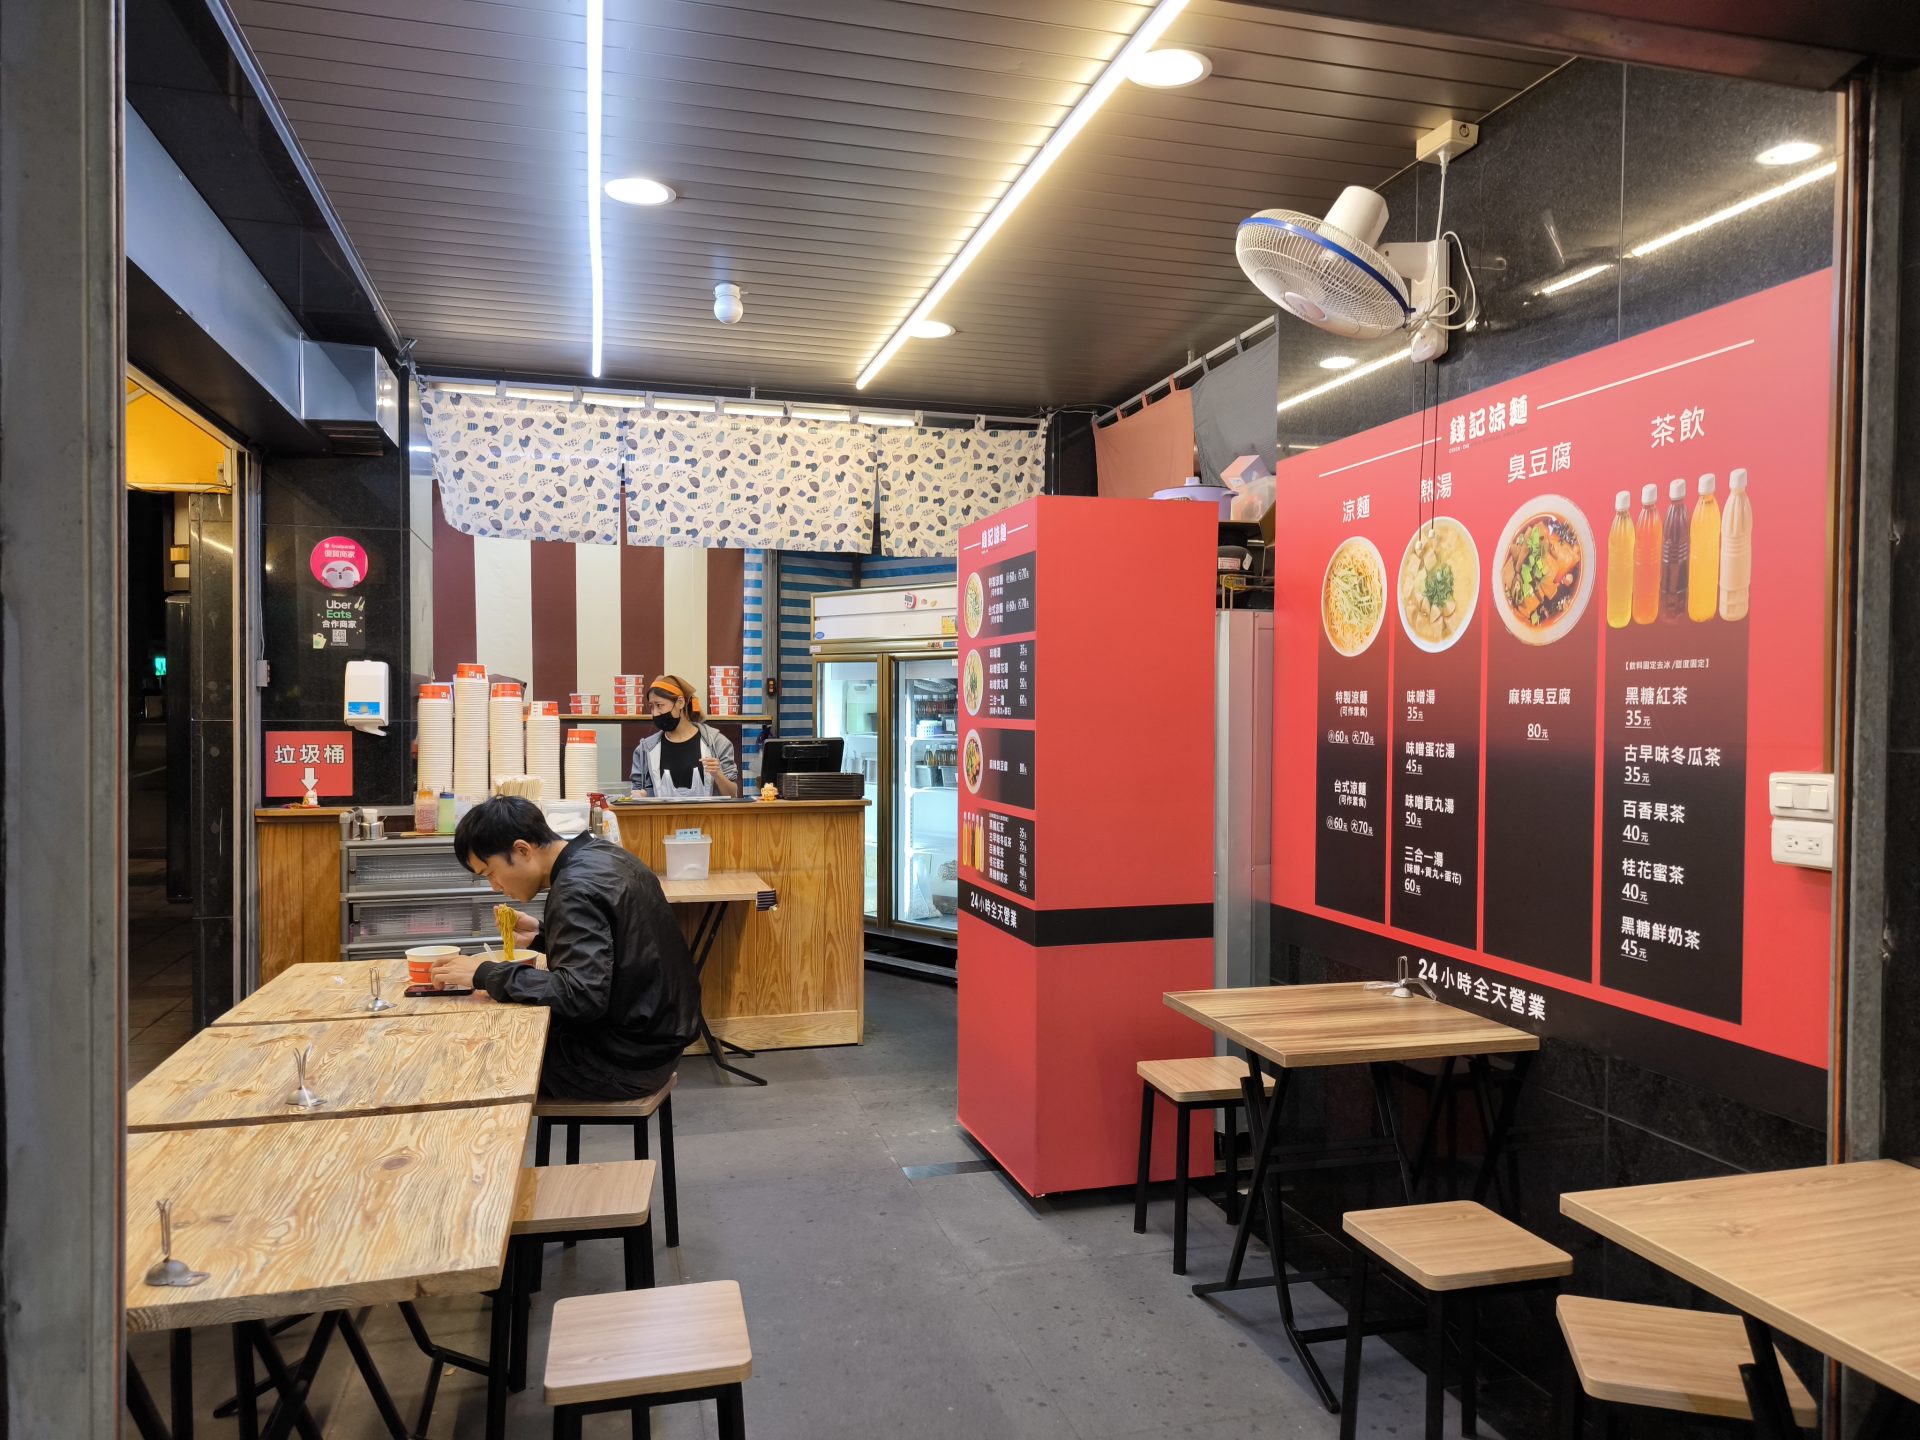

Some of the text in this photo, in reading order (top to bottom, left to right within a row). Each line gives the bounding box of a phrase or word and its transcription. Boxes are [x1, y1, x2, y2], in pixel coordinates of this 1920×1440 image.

[1449, 394, 1528, 445] 錢記涼麵
[1650, 406, 1706, 448] 茶飲
[1507, 441, 1572, 484] 臭豆腐
[1342, 494, 1370, 523] 涼麵
[326, 600, 352, 609] Uber
[326, 610, 352, 618] Eats
[322, 620, 357, 629] 合作商家
[1335, 690, 1368, 704] 特製涼麵
[1406, 689, 1435, 704] 味噌湯
[1508, 688, 1571, 705] 麻辣臭豆腐
[1625, 686, 1688, 705] 黑糖紅茶
[1407, 706, 1424, 720] 35元
[1625, 709, 1651, 727] 35元
[1527, 723, 1549, 739] 80元
[274, 744, 345, 764] 垃圾桶
[1405, 741, 1455, 758] 味噌蛋花湯
[1624, 744, 1721, 767] 古早味冬瓜茶
[1406, 759, 1423, 773] 45元
[1624, 766, 1650, 783] 35元
[1334, 779, 1367, 796] 台式涼麵
[1405, 794, 1455, 814] 味噌貢丸湯
[1622, 800, 1686, 824] 百香果茶
[1405, 812, 1422, 827] 50元
[1622, 824, 1650, 843] 40元
[1404, 845, 1444, 868] 三合一湯
[1404, 863, 1462, 886] (味噌+貢丸+蛋花)
[1622, 857, 1685, 885] 桂花蜜茶
[1404, 878, 1422, 894] 60元
[1622, 882, 1649, 903] 40元
[970, 891, 1018, 929] 24小時全天營業
[1621, 915, 1700, 950] 黑糖鮮奶茶
[1621, 938, 1648, 960] 45元
[1418, 958, 1546, 1021] 24小時全天營業
